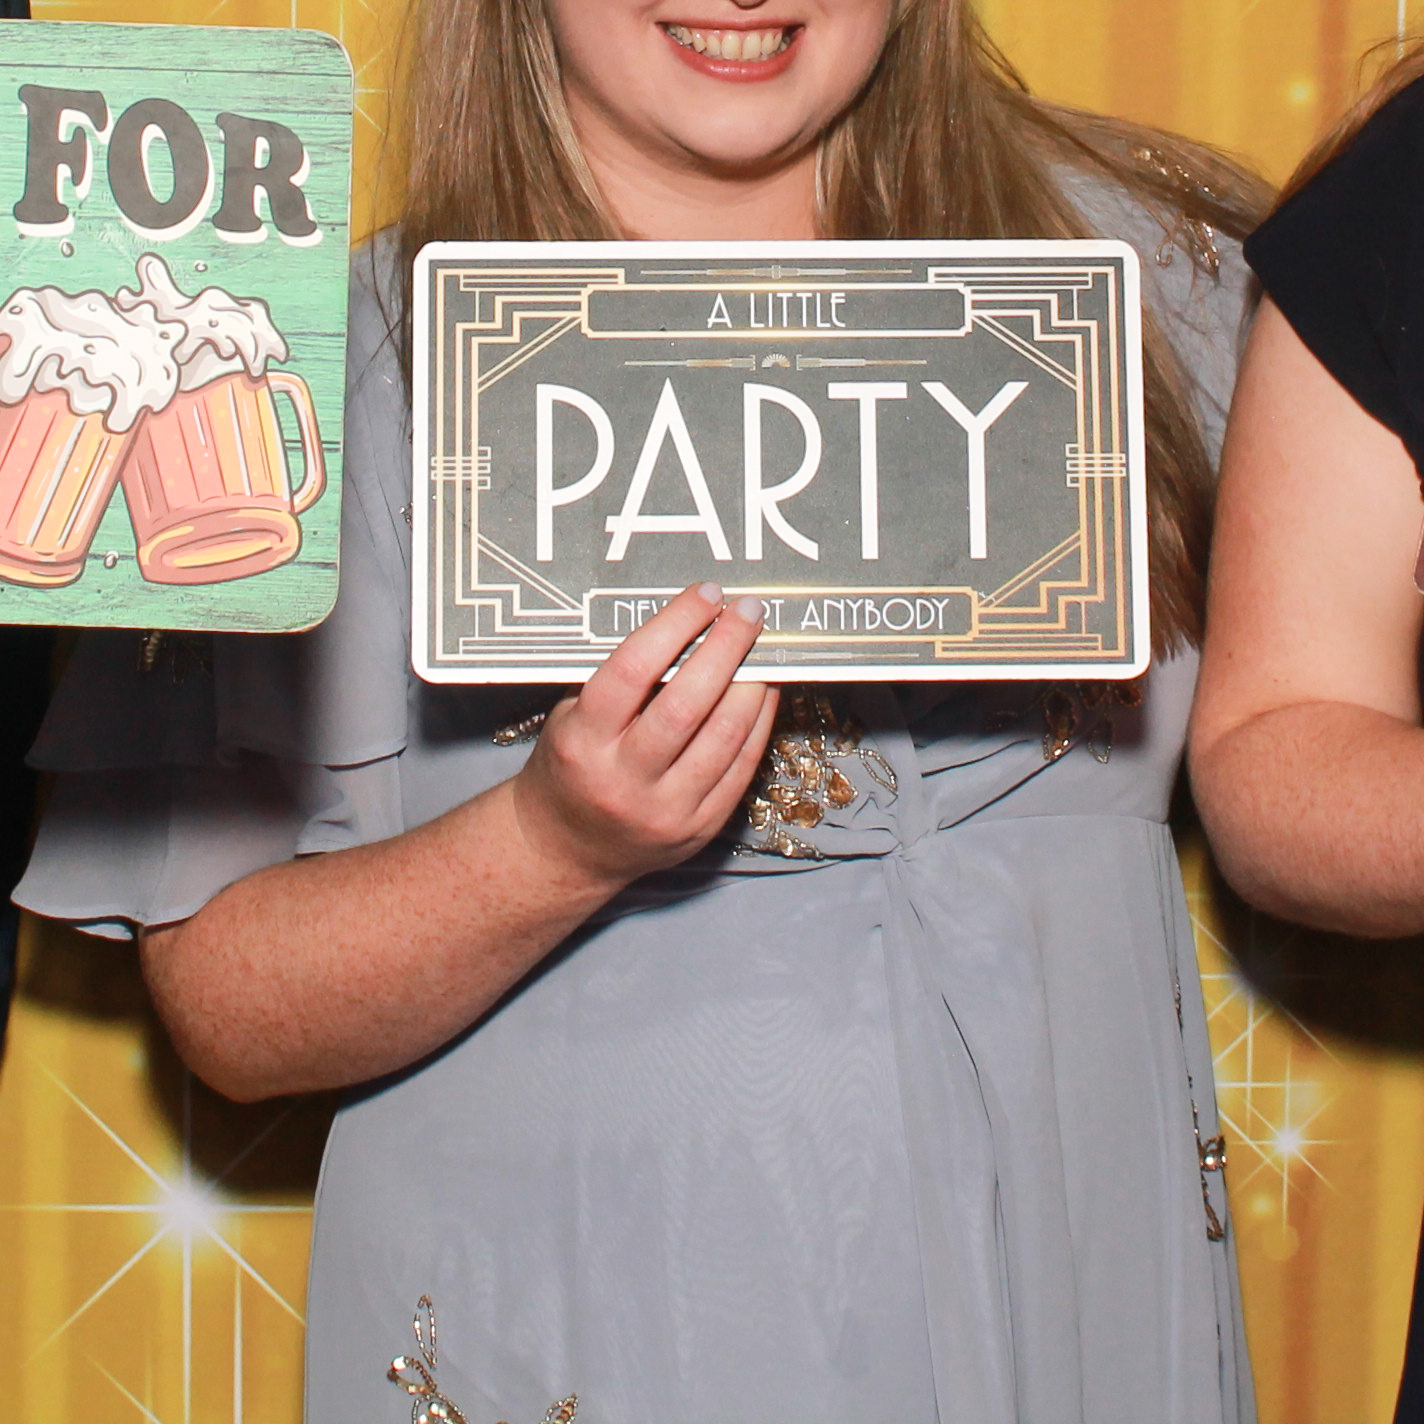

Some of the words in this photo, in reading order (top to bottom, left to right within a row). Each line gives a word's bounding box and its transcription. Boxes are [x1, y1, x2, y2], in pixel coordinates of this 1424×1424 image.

[13, 83, 322, 246] FOR
[707, 292, 733, 328] A
[750, 292, 847, 328] LITTLE
[535, 376, 1029, 562] PARTY
[800, 598, 949, 632] ANYBODY
